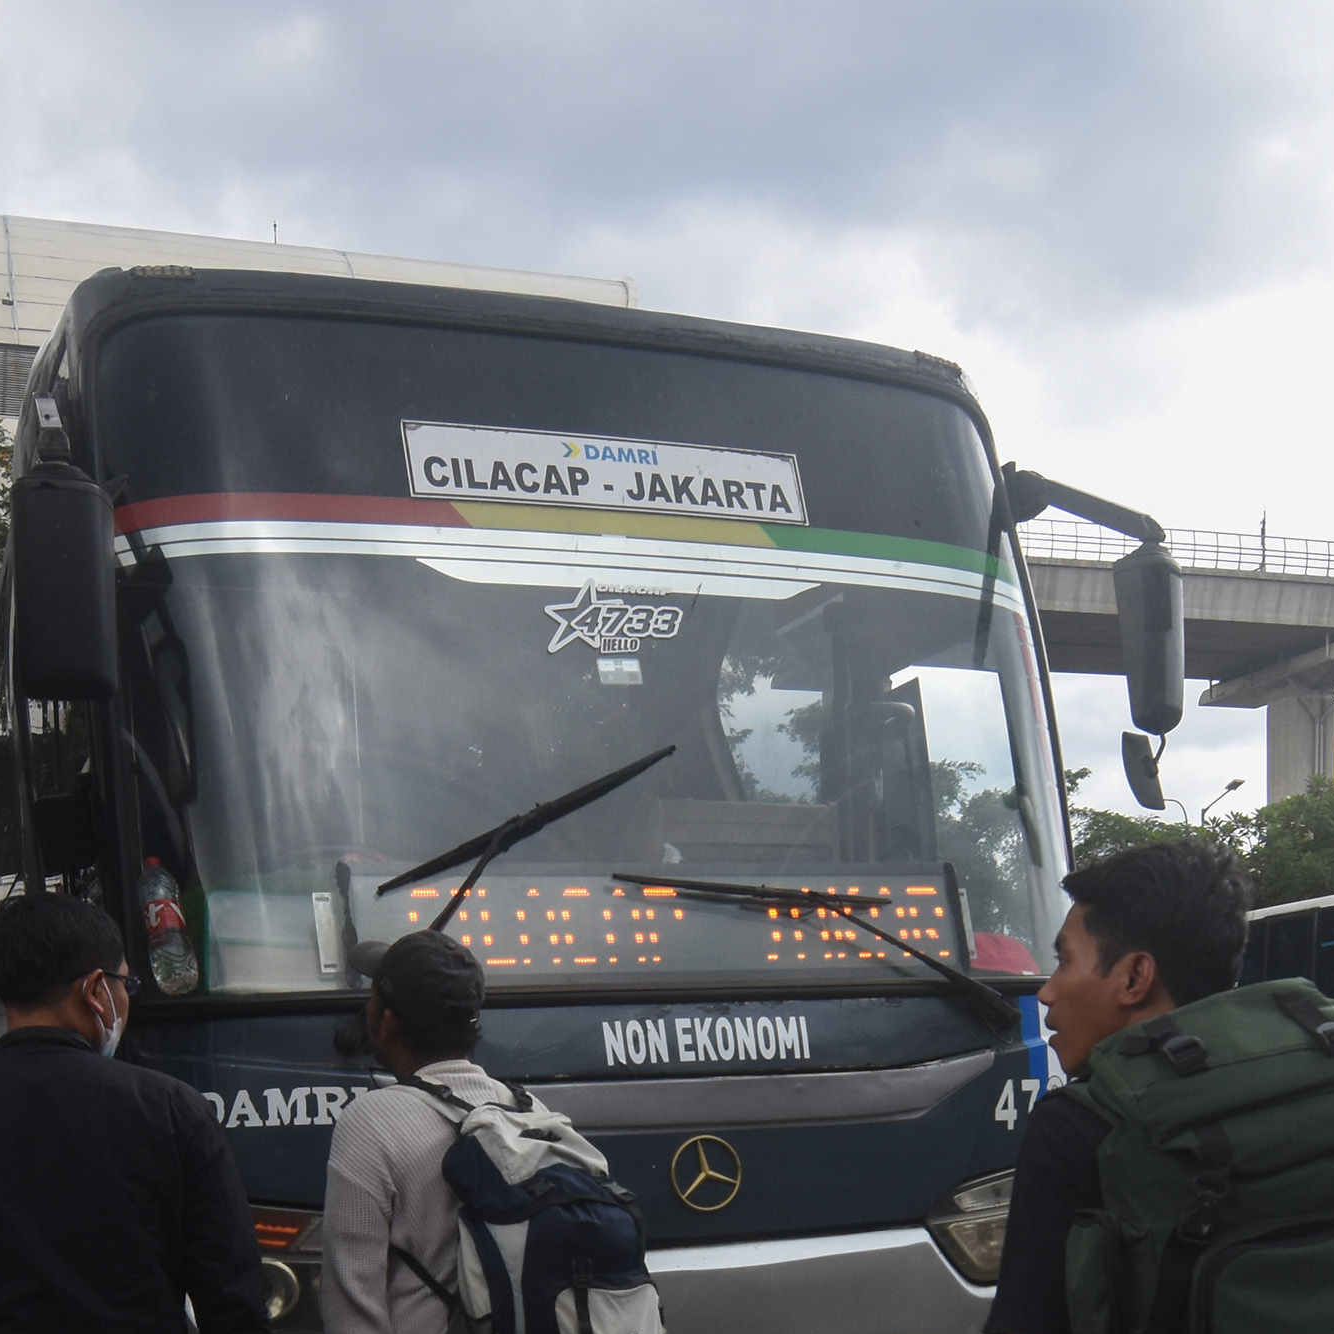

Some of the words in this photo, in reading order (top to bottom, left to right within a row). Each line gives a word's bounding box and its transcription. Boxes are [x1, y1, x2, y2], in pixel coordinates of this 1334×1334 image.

[584, 444, 658, 466] DAMRI
[423, 456, 589, 496] CILACAP
[626, 471, 793, 514] JAKARTA
[571, 605, 683, 638] 4733
[602, 638, 640, 652] HELLO
[602, 1018, 669, 1066] NON
[674, 1016, 811, 1062] EKONOMI
